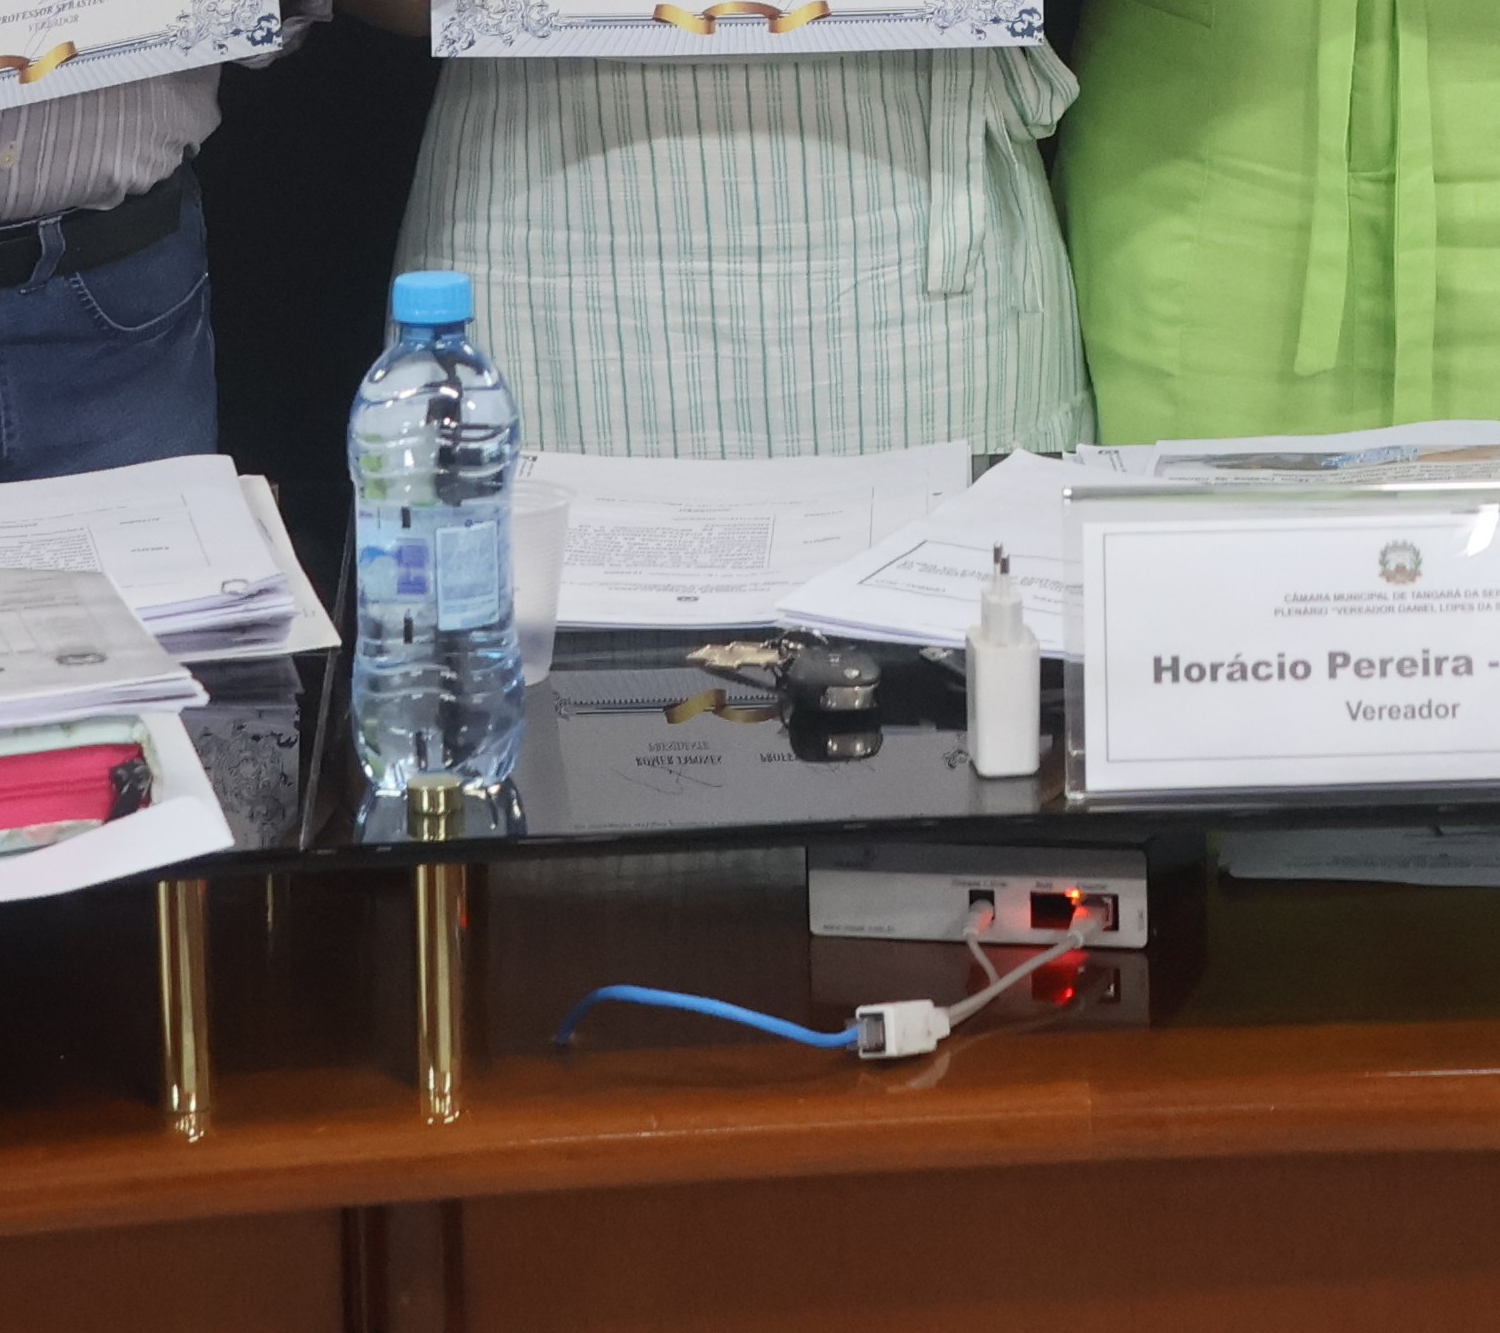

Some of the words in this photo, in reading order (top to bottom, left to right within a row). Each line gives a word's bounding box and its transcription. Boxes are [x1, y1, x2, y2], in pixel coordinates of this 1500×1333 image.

[1153, 653, 1311, 684] Horácio
[1328, 649, 1473, 679] Pereira
[1346, 699, 1460, 721] Vereador
